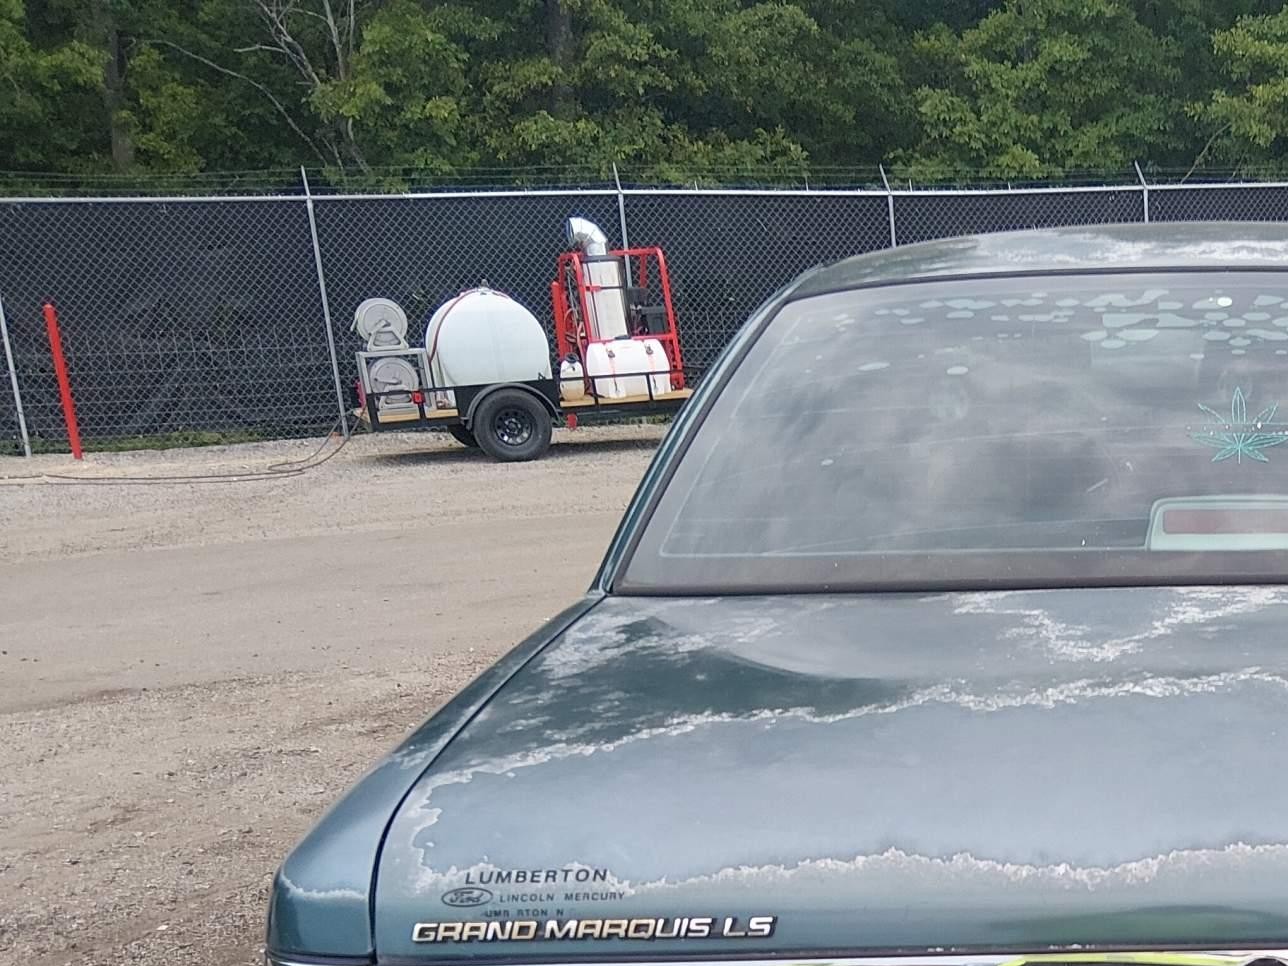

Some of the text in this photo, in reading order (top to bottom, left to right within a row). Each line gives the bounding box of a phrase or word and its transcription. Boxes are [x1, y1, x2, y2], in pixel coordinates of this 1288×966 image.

[465, 868, 609, 885] LUMBERTON
[500, 893, 555, 903] LINCOLN
[564, 891, 625, 902] MERCURY
[411, 916, 774, 942] GRAND MARQUIS LS
